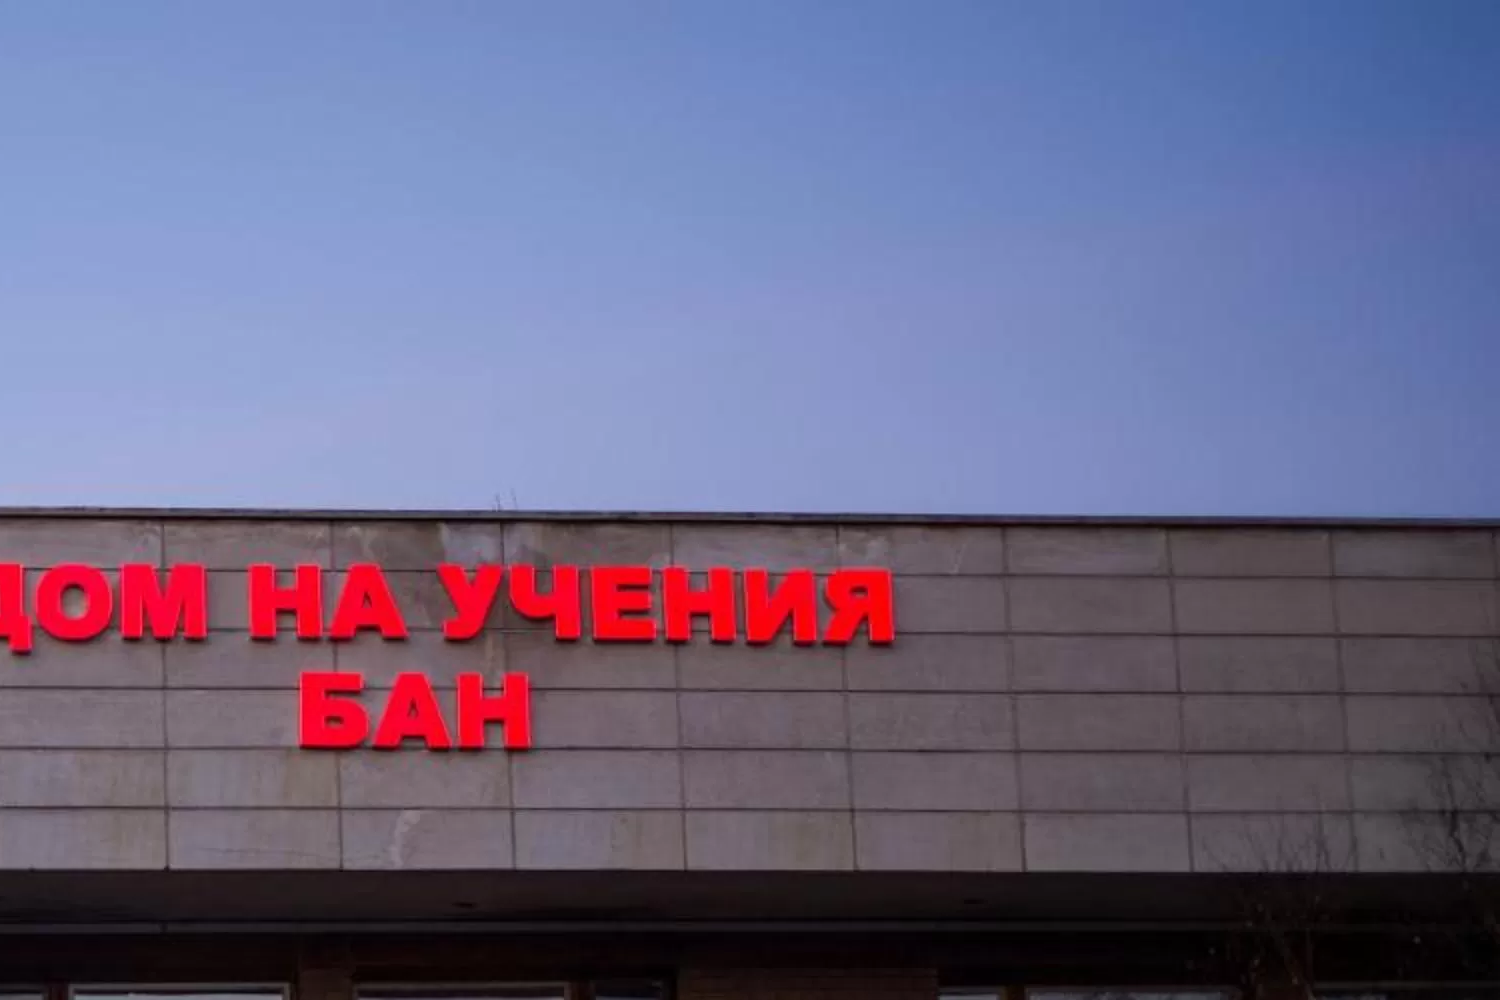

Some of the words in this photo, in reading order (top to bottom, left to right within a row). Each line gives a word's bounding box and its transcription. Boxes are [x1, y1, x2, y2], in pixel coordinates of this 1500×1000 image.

[249, 563, 408, 641] НА
[438, 564, 895, 646] УЧЕНИЯ
[300, 672, 532, 750] БАН
